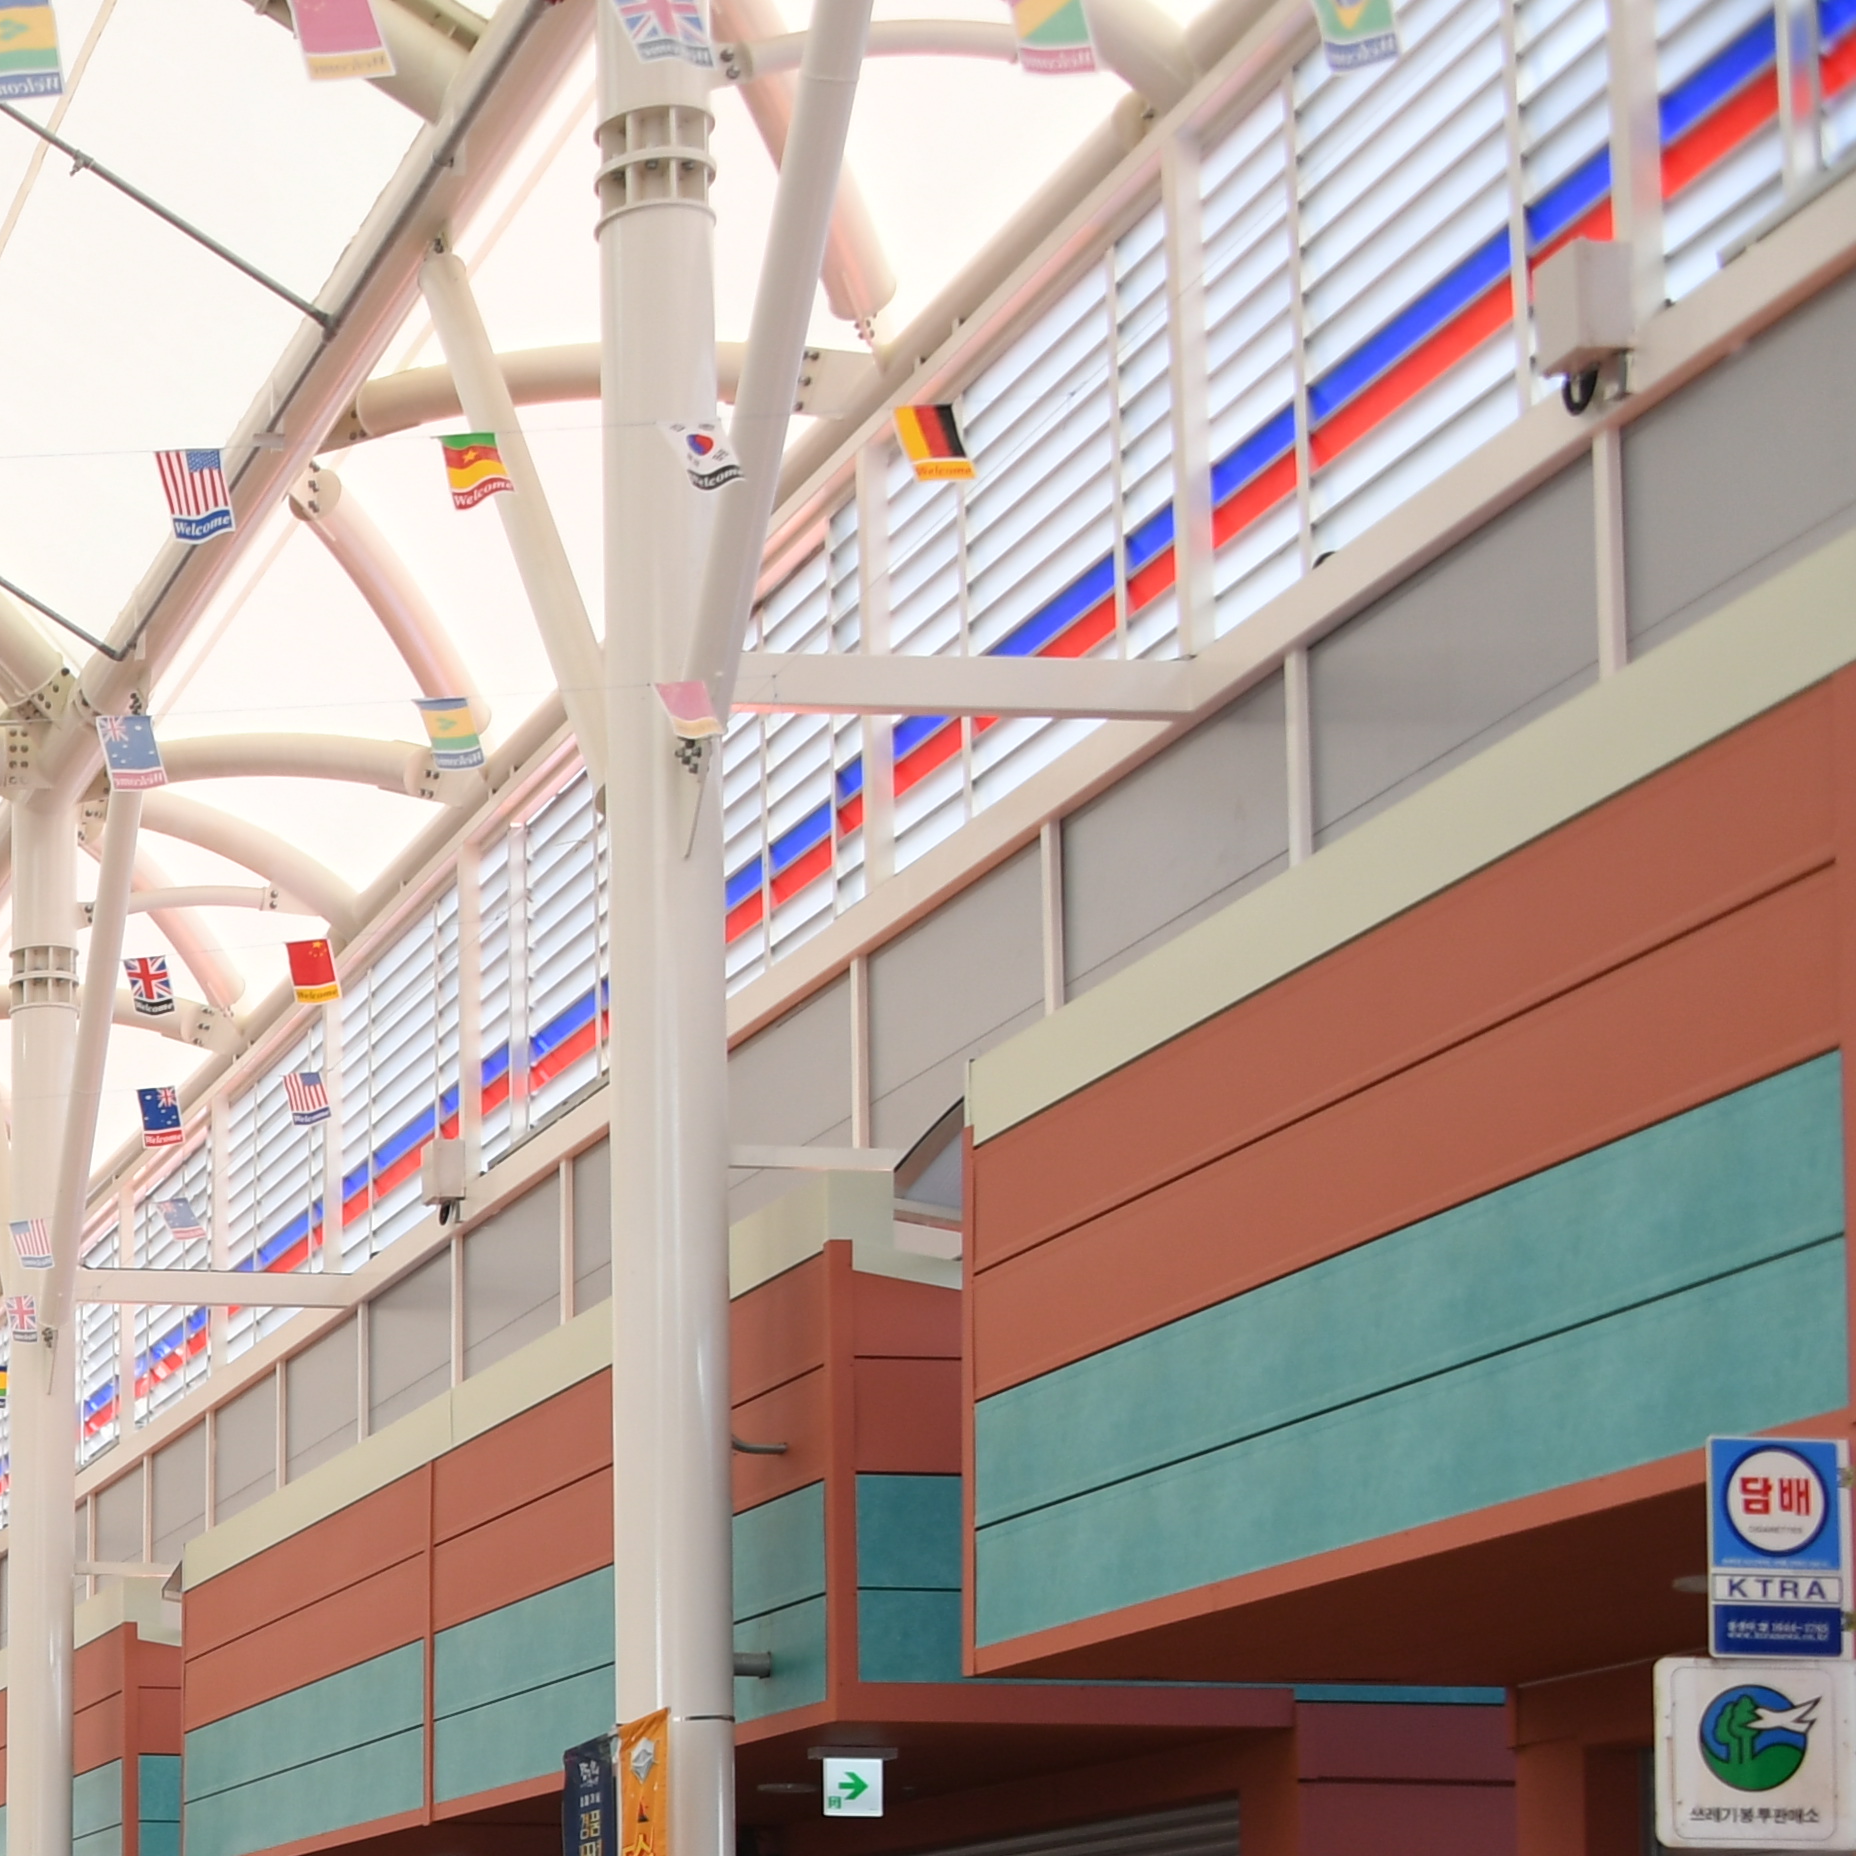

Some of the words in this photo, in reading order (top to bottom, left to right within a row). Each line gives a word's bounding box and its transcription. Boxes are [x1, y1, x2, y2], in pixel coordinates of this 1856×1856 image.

[1739, 1476, 1812, 1516] 담배
[1726, 1577, 1828, 1602] KTRA
[1689, 1806, 1821, 1825] 쓰레기봉투판매소
